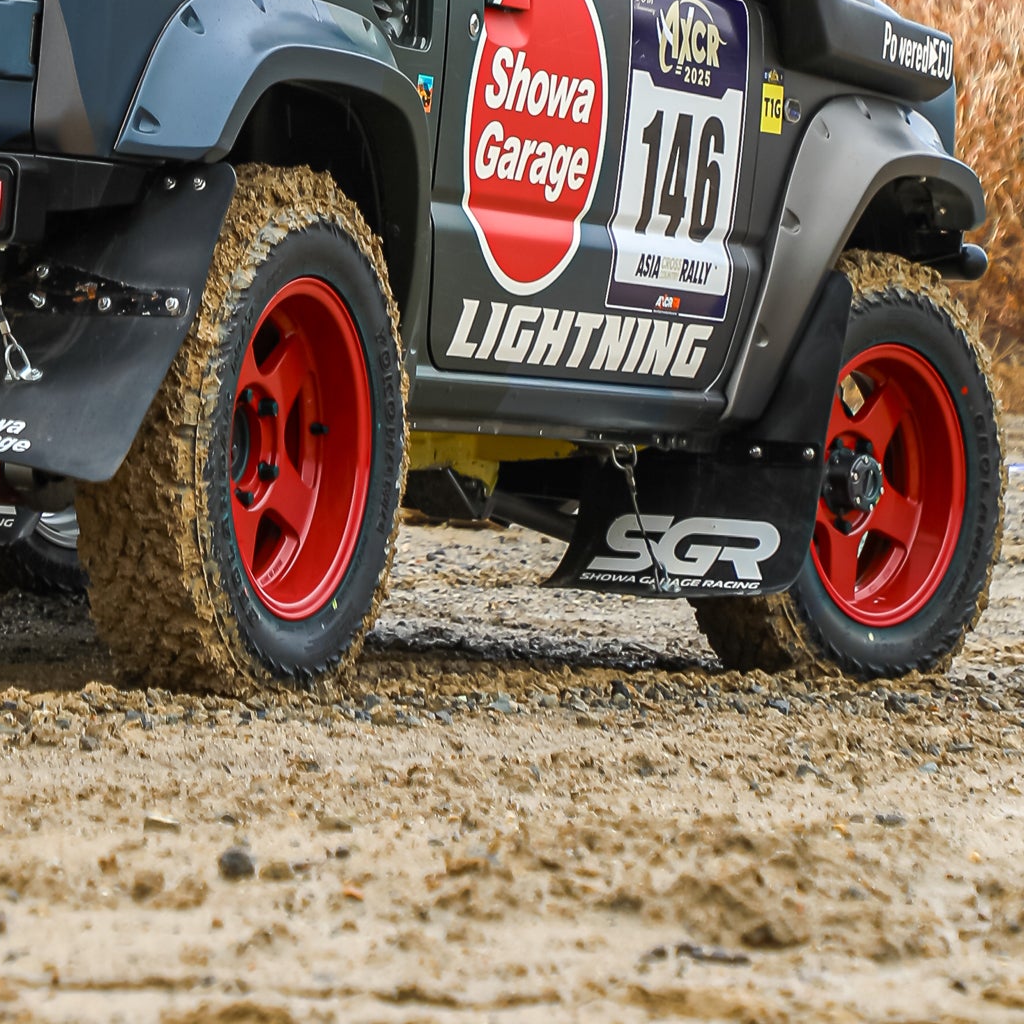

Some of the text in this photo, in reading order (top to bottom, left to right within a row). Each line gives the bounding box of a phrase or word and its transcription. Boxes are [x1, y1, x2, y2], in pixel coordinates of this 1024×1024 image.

[657, 0, 723, 74] AXCR
[485, 45, 596, 124] Showa
[684, 66, 711, 87] 2025
[475, 120, 590, 203] Garage
[634, 109, 726, 243] 146
[634, 253, 662, 279] ASIA
[679, 258, 713, 285] RALLY
[447, 298, 714, 378] LIGHTNING
[579, 572, 636, 584] SHOWA
[701, 579, 761, 590] RACING
[587, 513, 781, 581] SGR
